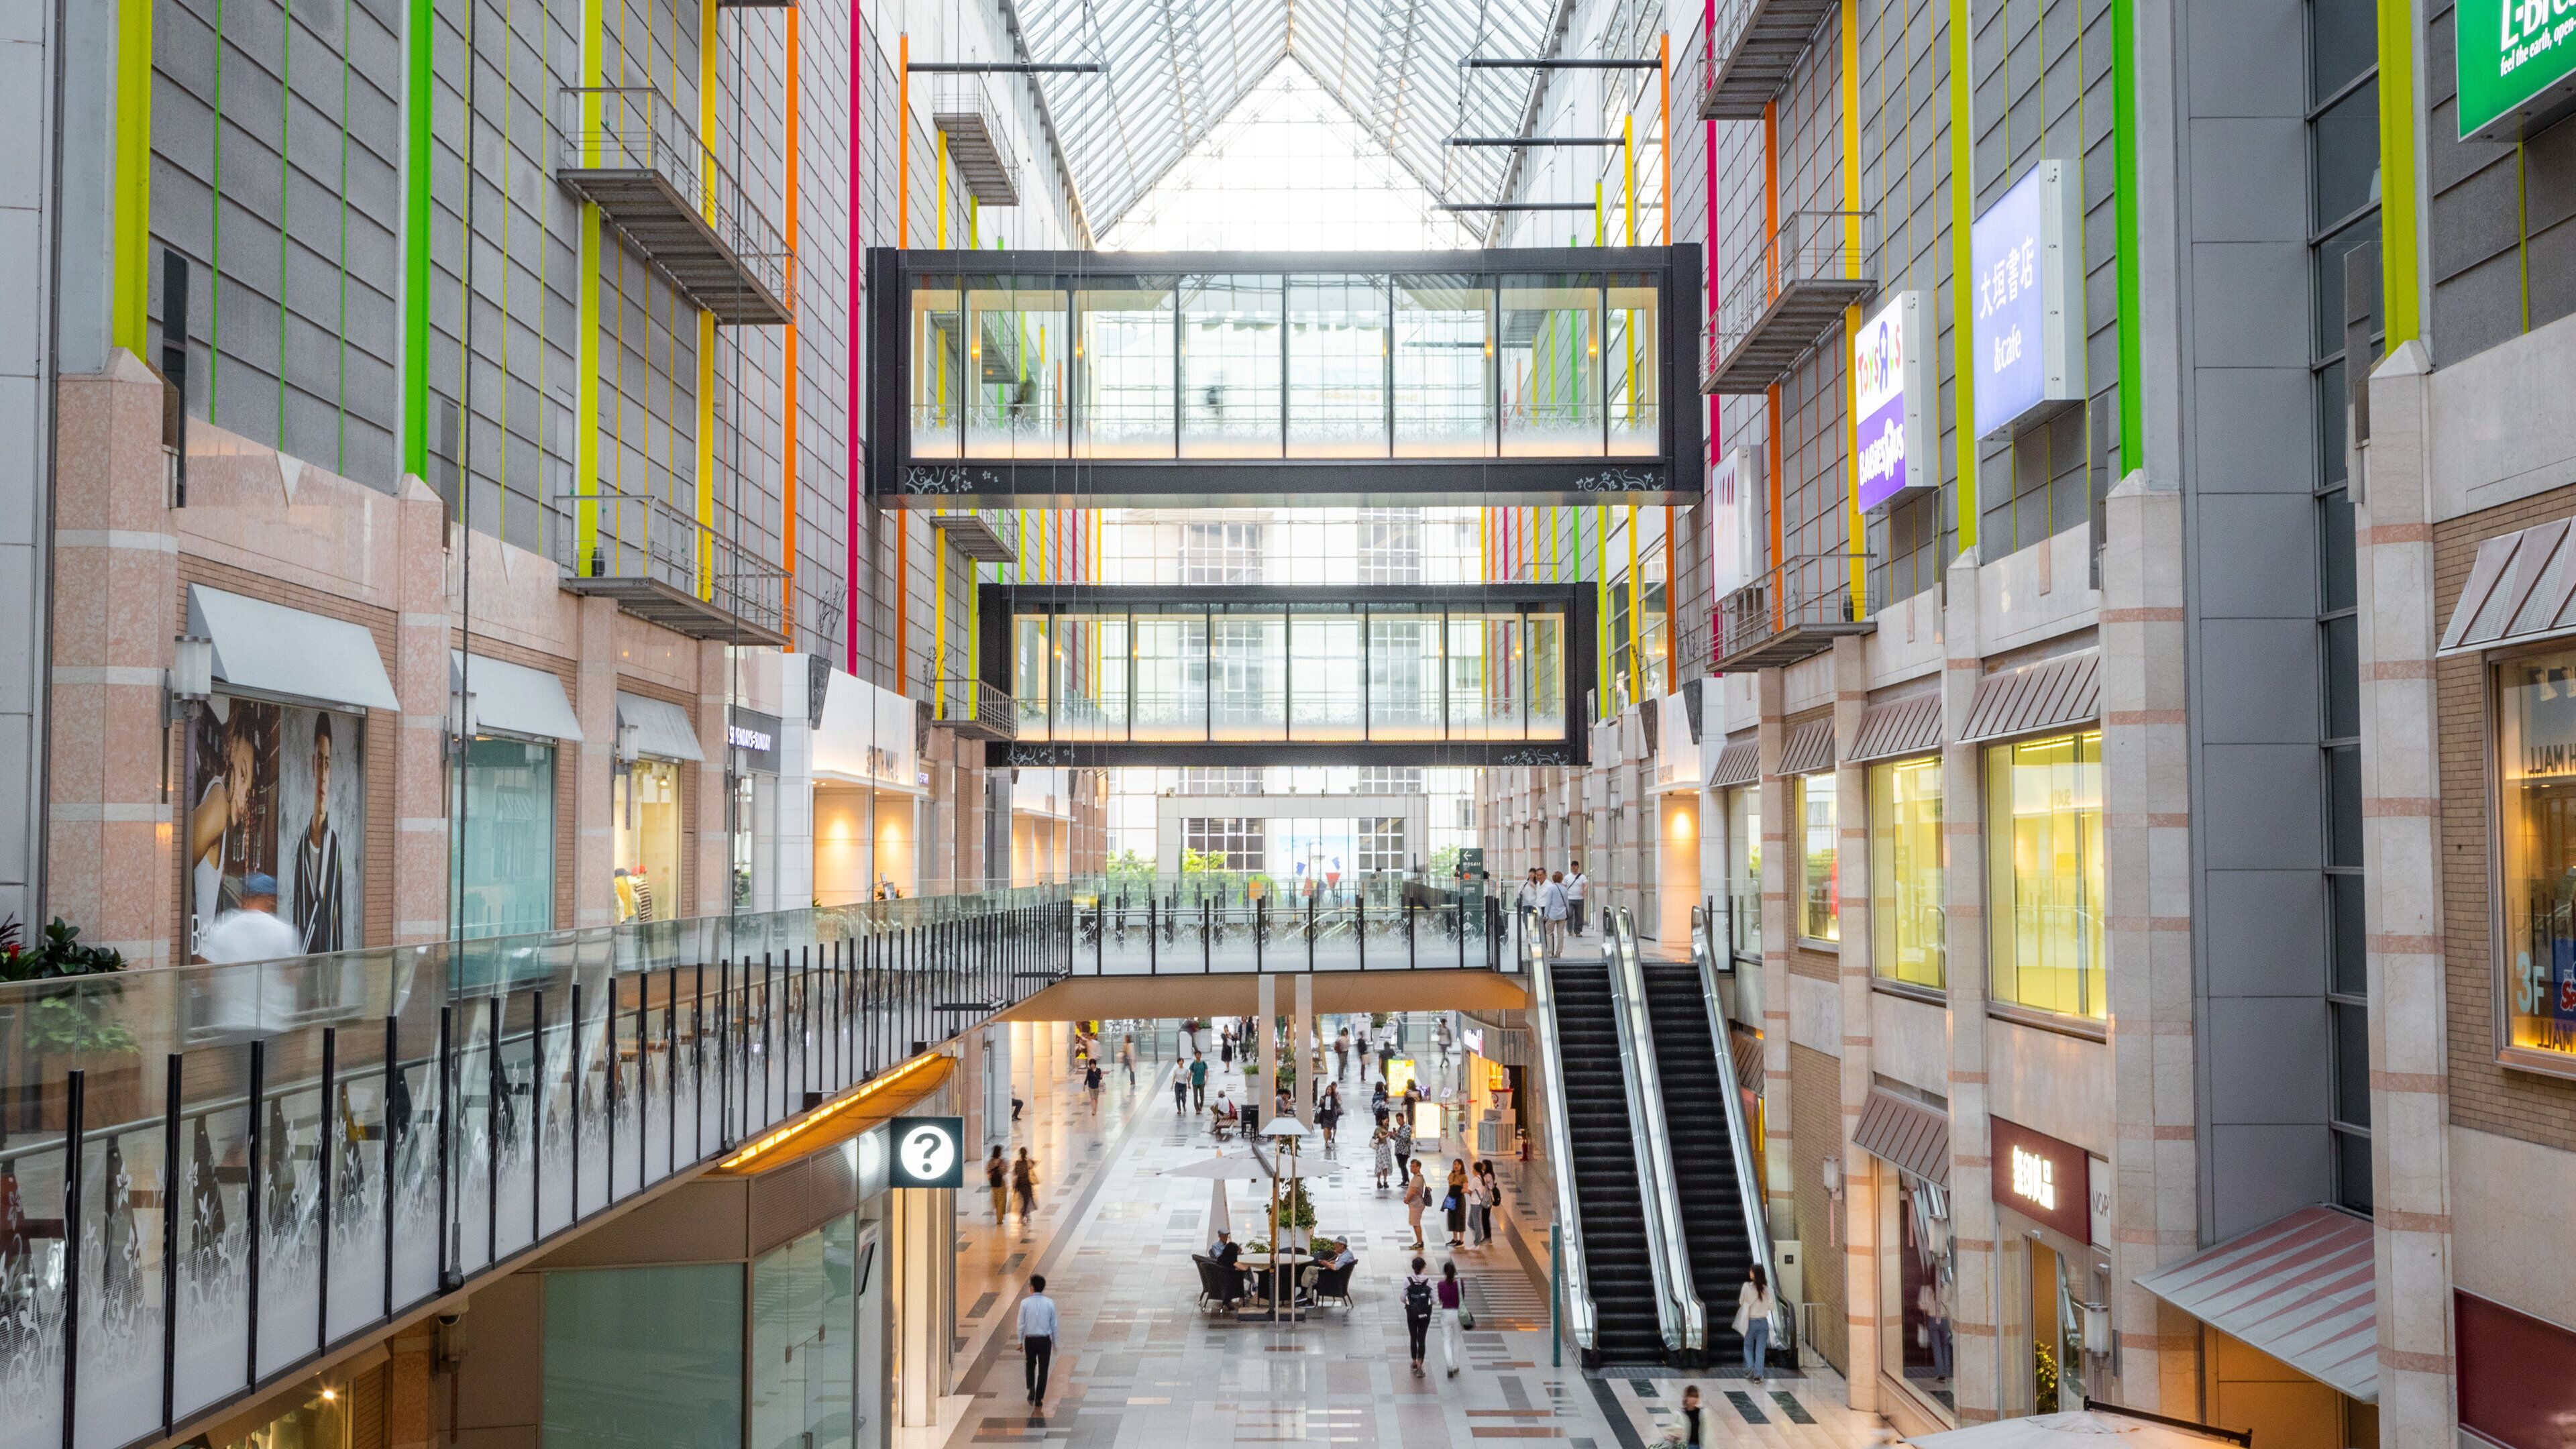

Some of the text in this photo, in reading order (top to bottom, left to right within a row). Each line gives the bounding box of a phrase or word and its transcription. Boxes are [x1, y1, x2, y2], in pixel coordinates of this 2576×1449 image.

[2500, 55, 2516, 77] feel
[2516, 44, 2529, 66] the
[2530, 27, 2552, 58] earth,
[1980, 235, 2035, 320] 大垣書店
[1994, 323, 2022, 374] &cafe
[2516, 951, 2545, 1016] 3F
[2092, 1190, 2110, 1218] NOR
